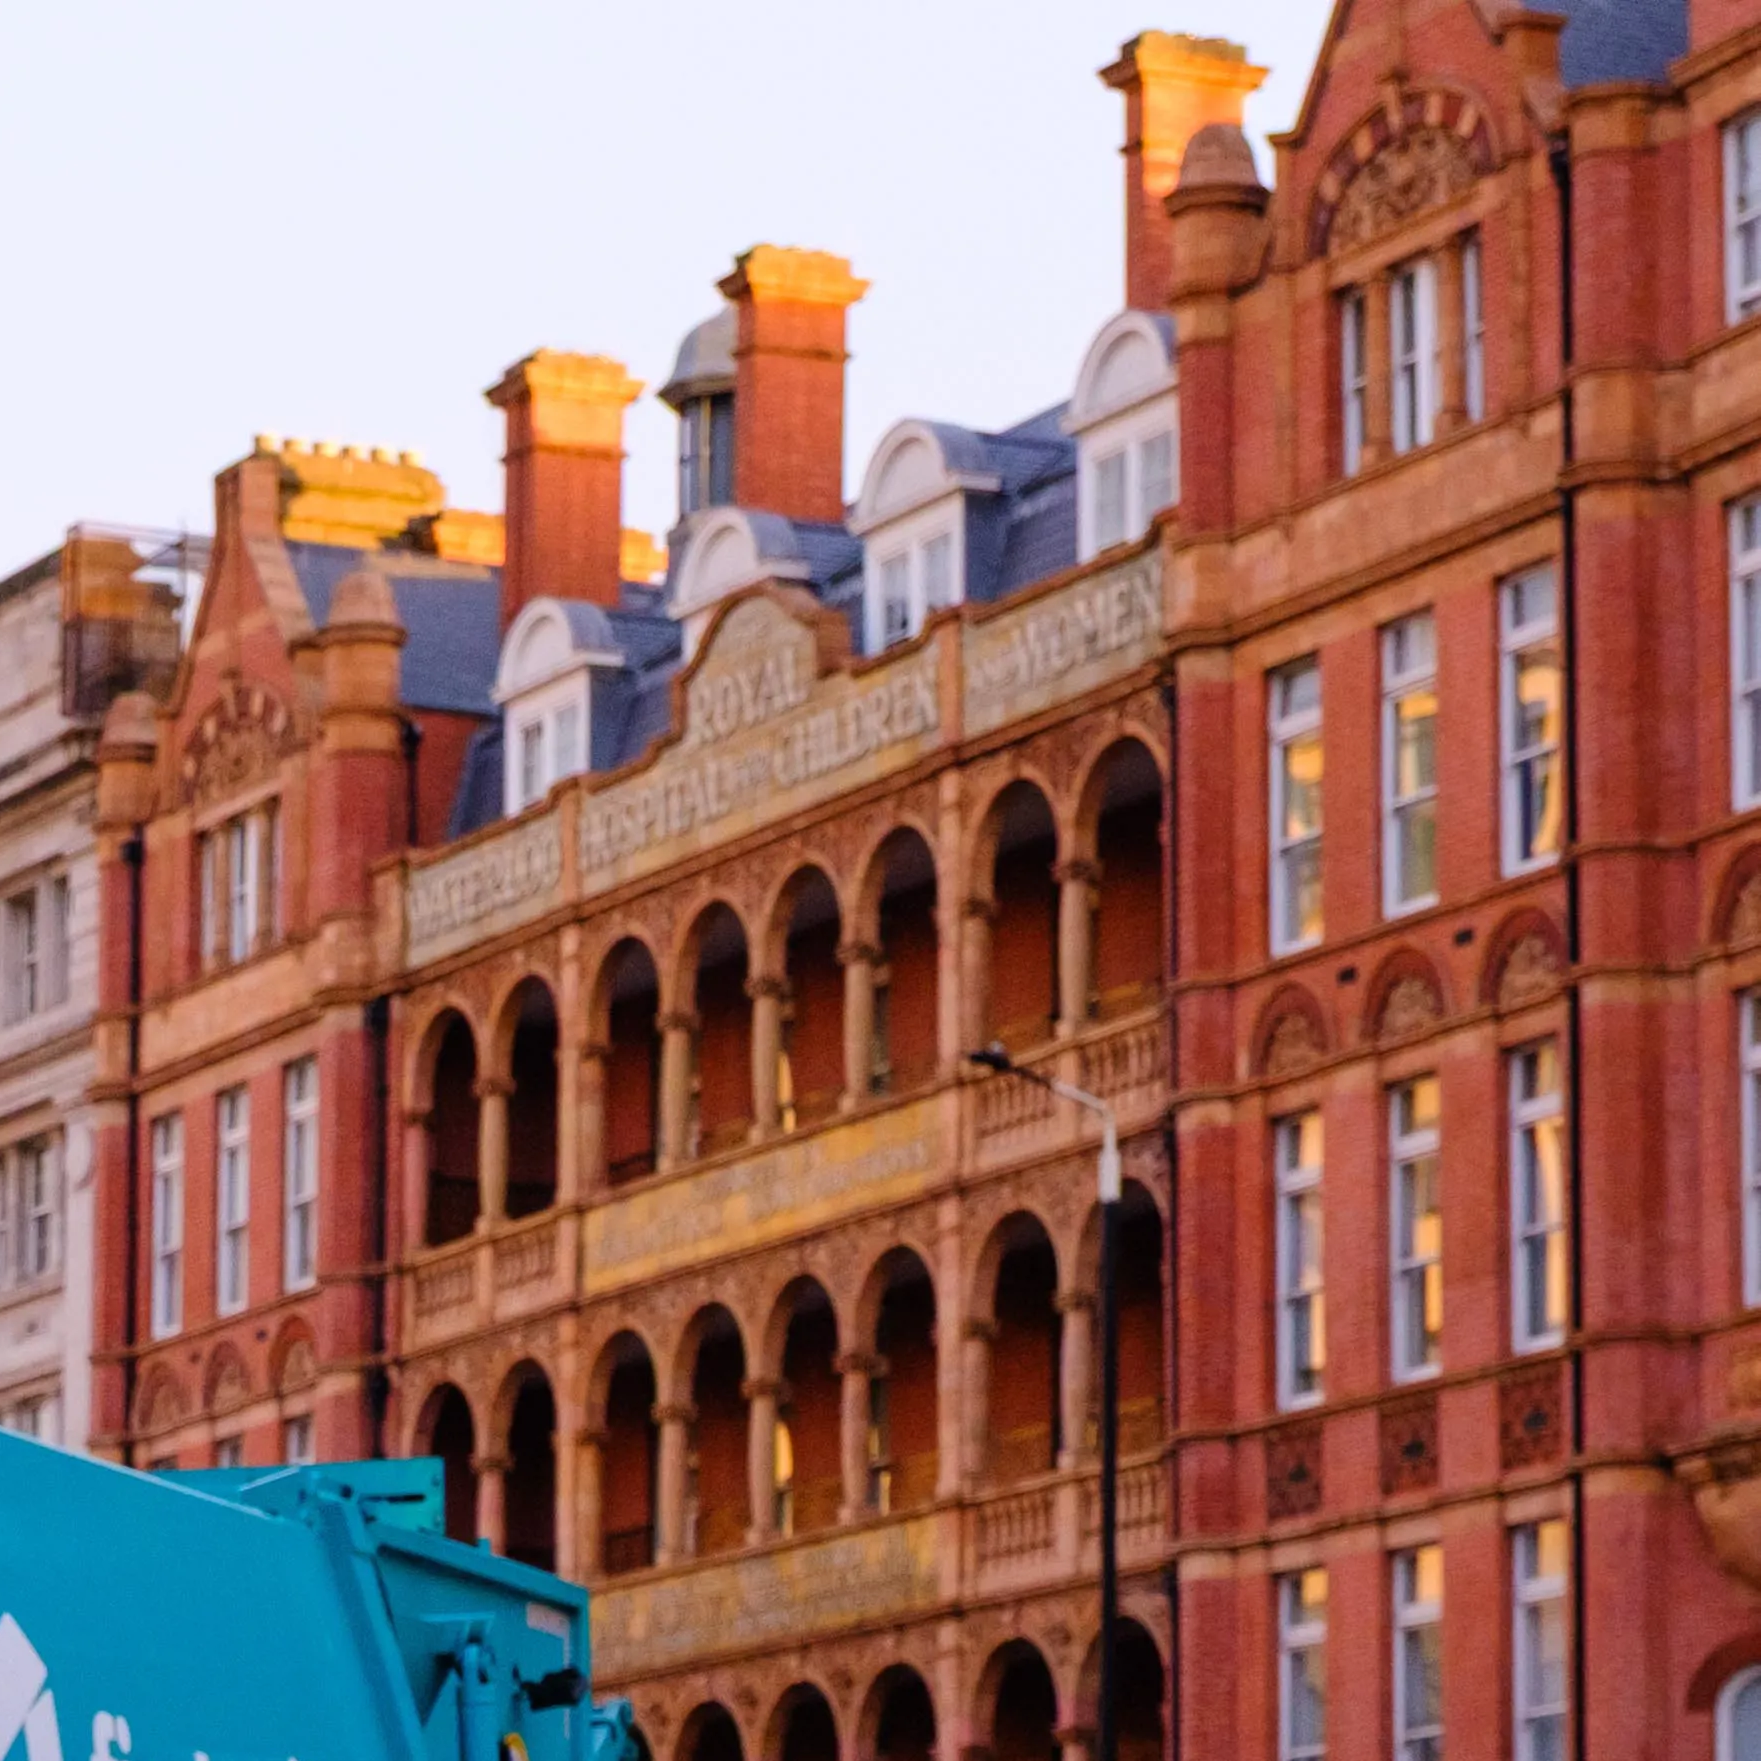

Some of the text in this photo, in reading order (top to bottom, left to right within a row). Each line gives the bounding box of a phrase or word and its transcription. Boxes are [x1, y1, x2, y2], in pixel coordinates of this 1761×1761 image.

[409, 832, 561, 942] WATERLOO
[580, 756, 731, 878] HOSPITAL
[774, 645, 941, 790] CHILDREN
[1023, 560, 1164, 690] WOMEN
[689, 648, 809, 746] ROYAL
